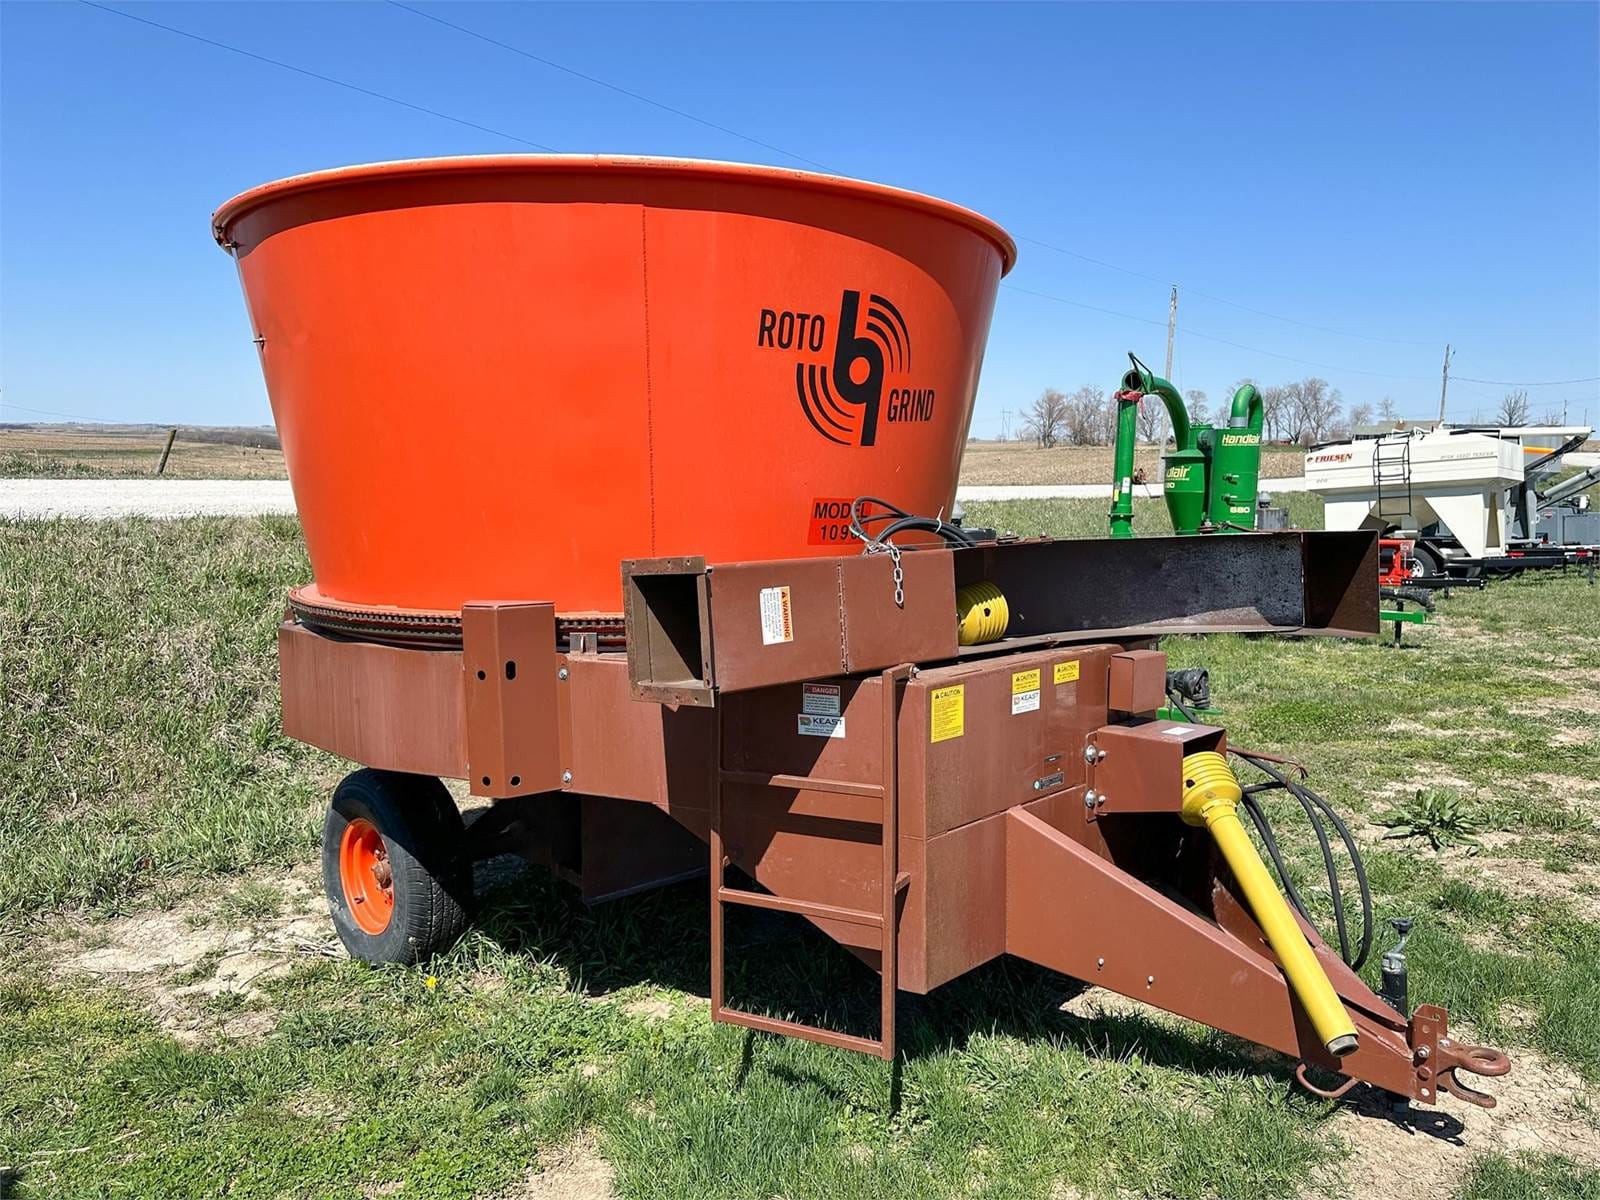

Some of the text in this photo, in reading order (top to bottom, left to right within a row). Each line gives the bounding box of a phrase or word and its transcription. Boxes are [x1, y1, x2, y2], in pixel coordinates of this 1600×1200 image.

[758, 309, 825, 352] ROTO
[887, 388, 935, 422] GRIND
[1222, 433, 1260, 444] Handlair
[1315, 453, 1353, 463] FRIESEN
[820, 524, 860, 541] 109
[782, 599, 791, 638] WARNING
[1021, 673, 1038, 681] CAUTION
[812, 686, 838, 695] DANGER
[940, 689, 961, 698] CAUTION
[1021, 691, 1039, 700] KEAST
[813, 717, 842, 726] KEAST
